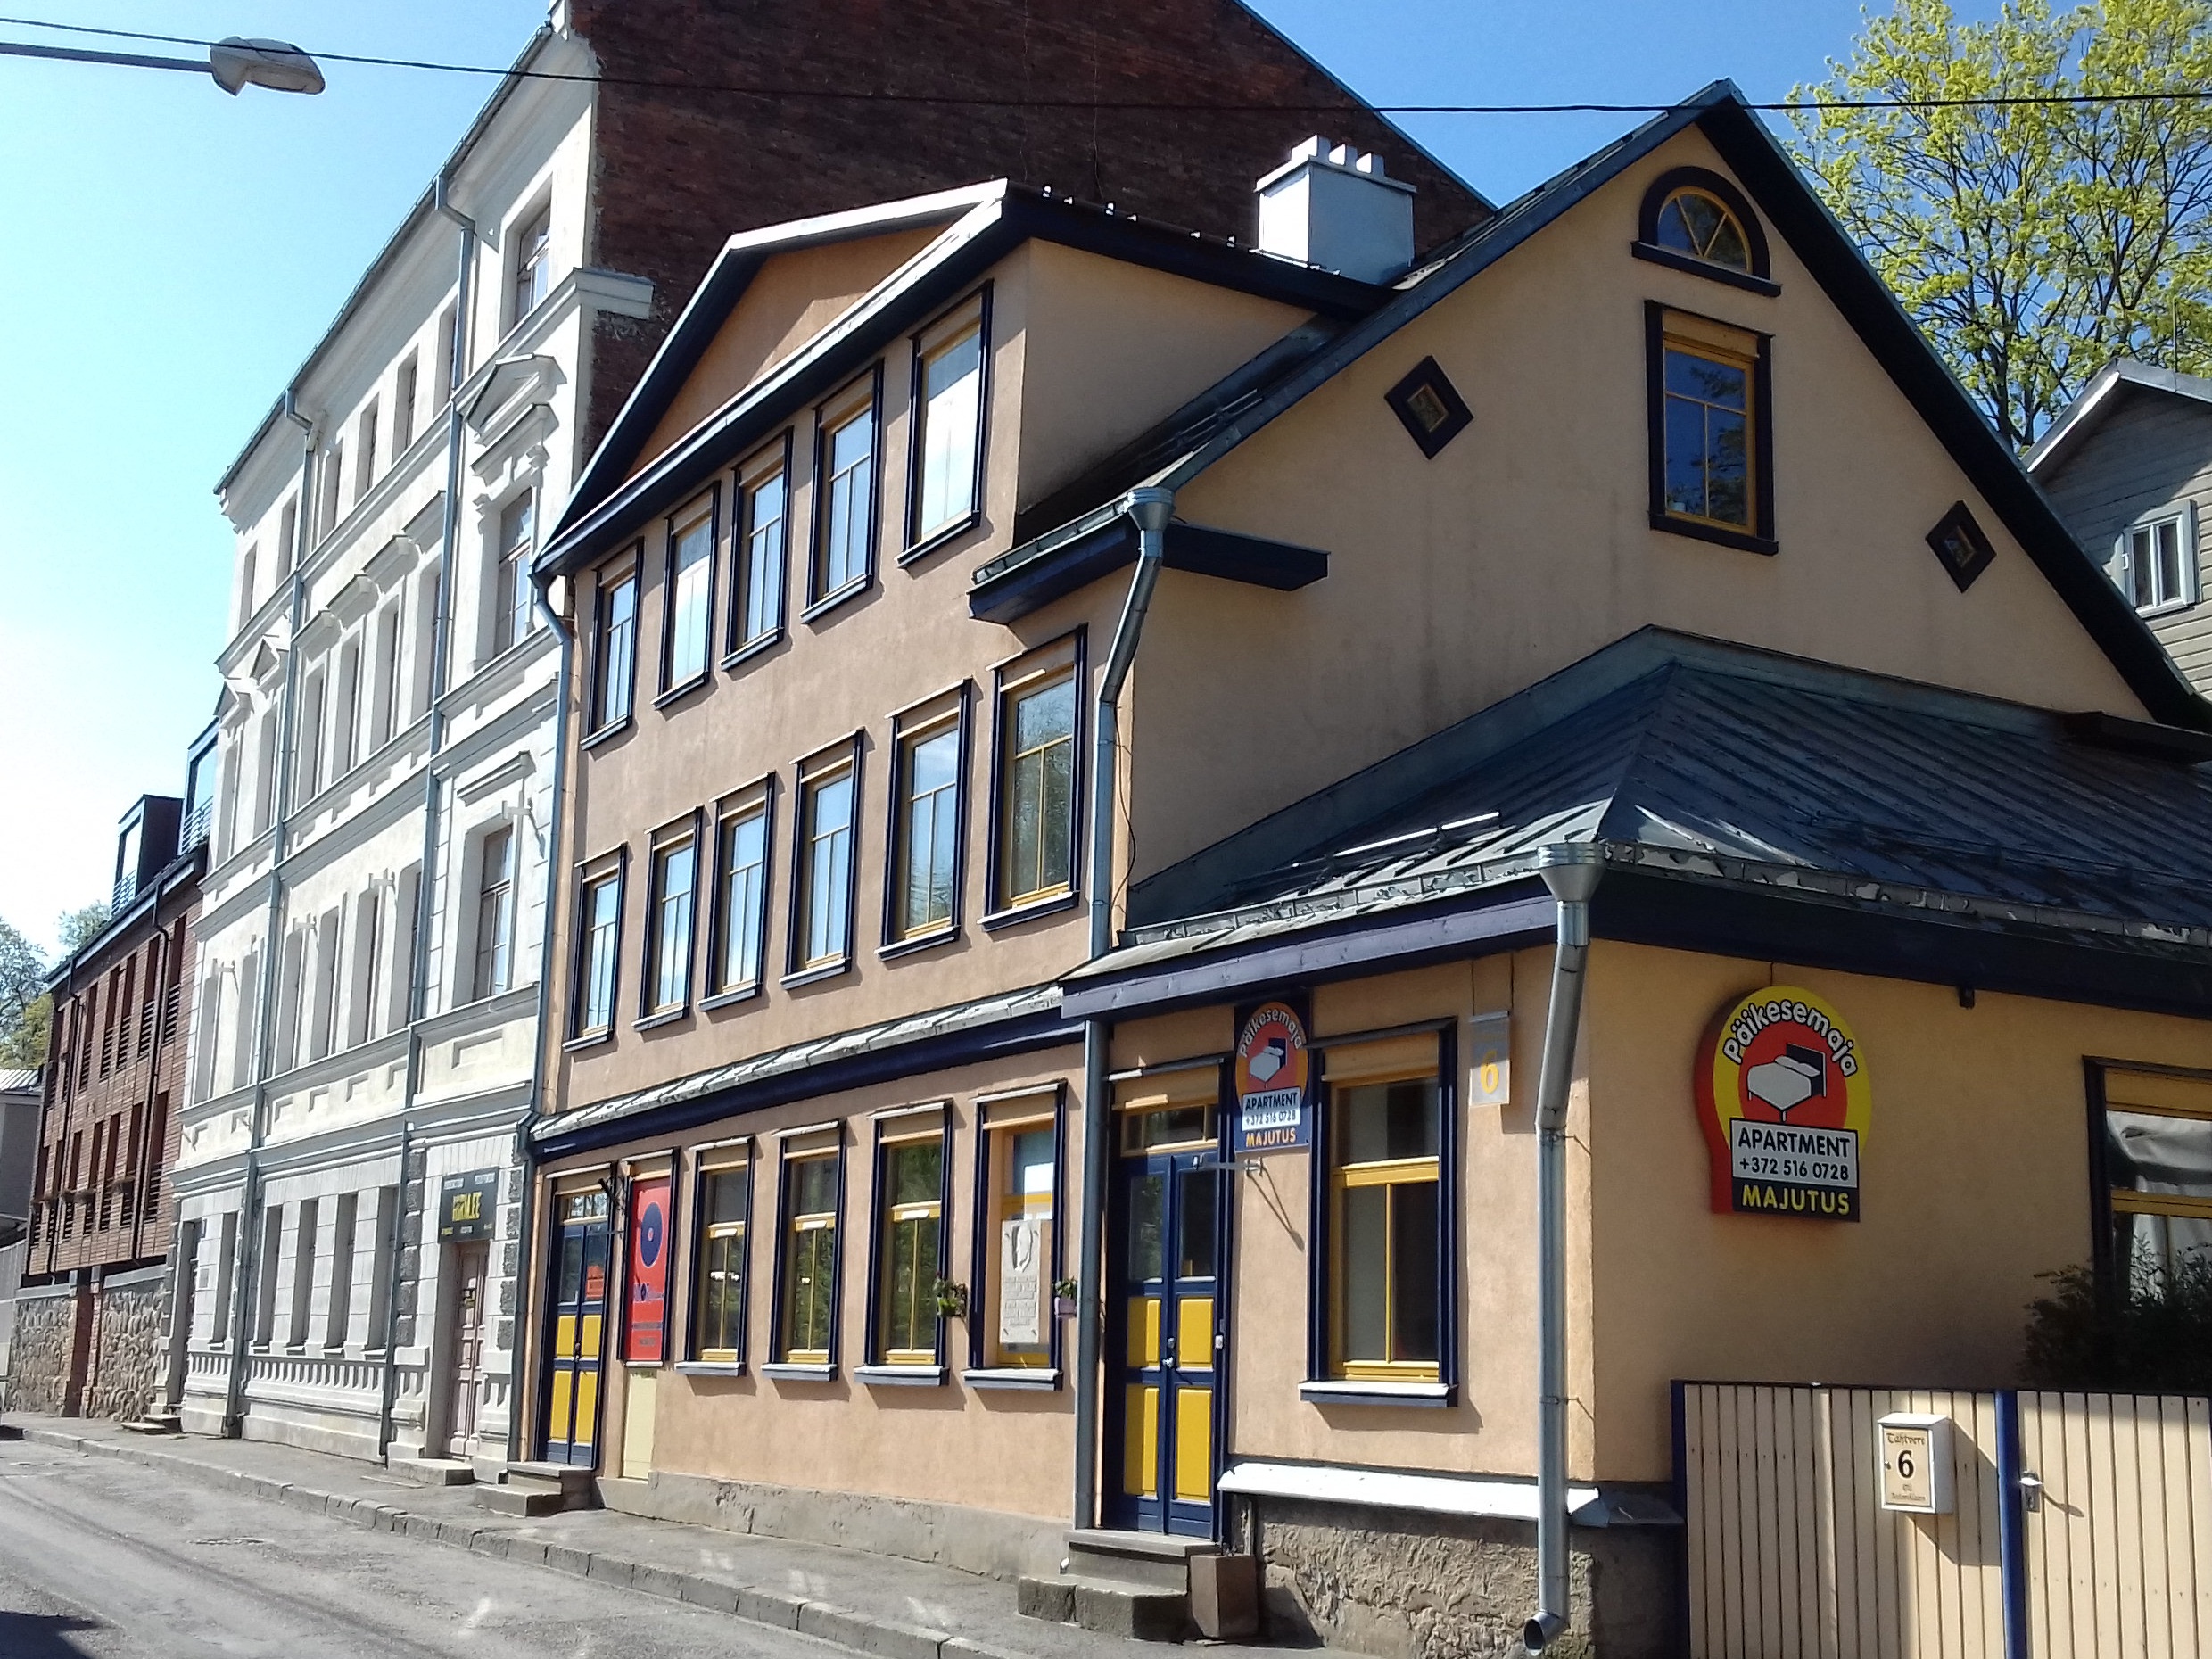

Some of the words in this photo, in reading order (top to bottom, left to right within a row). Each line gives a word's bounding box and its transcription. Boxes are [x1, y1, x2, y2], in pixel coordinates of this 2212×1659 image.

[1239, 1009, 1302, 1058] Päikesemaja
[1722, 998, 1858, 1077] Päikesemaja
[1480, 1050, 1499, 1094] 6
[1245, 1093, 1298, 1110] APARTMENT
[1246, 1127, 1297, 1147] MAJUTUS
[1737, 1127, 1851, 1158] APARTMENT
[1739, 1157, 1779, 1175] +372
[1783, 1160, 1808, 1177] 516
[1812, 1162, 1849, 1181] 0728
[1742, 1184, 1851, 1215] MAJUTUS
[1898, 1449, 1915, 1478] 6
